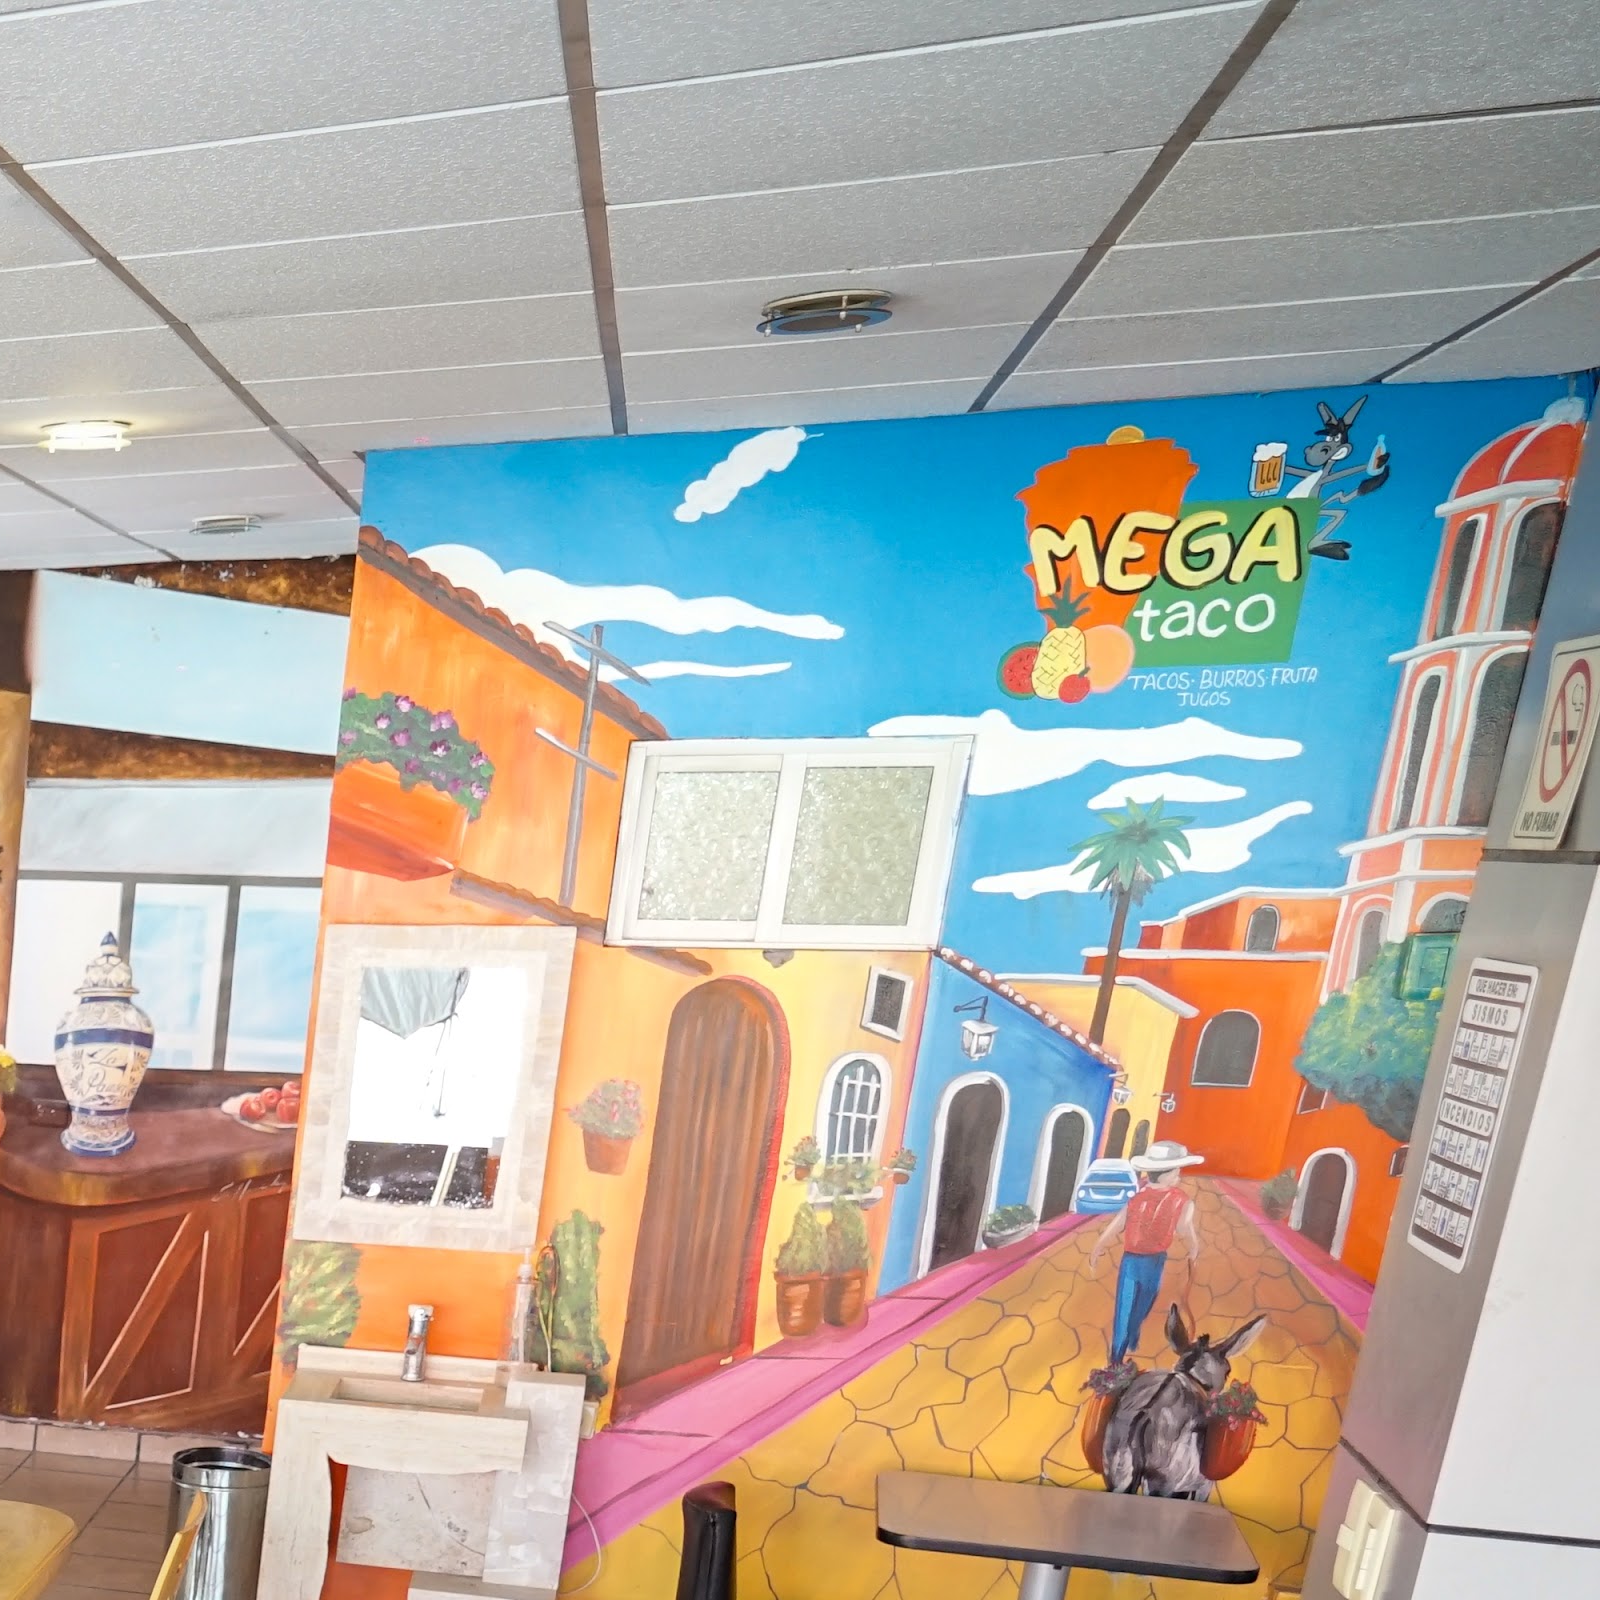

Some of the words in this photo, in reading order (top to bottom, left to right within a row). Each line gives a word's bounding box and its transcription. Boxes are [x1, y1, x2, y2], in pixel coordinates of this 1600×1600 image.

[1029, 505, 1302, 597] MEGA
[1133, 593, 1277, 642] taco
[1271, 667, 1318, 686] FRUTA
[1176, 691, 1231, 707] JUGOS
[1519, 811, 1535, 831] NO
[1533, 811, 1560, 832] FUMAR
[1471, 1004, 1509, 1027] SISMOS
[1440, 1101, 1492, 1133] INCENDIOS
